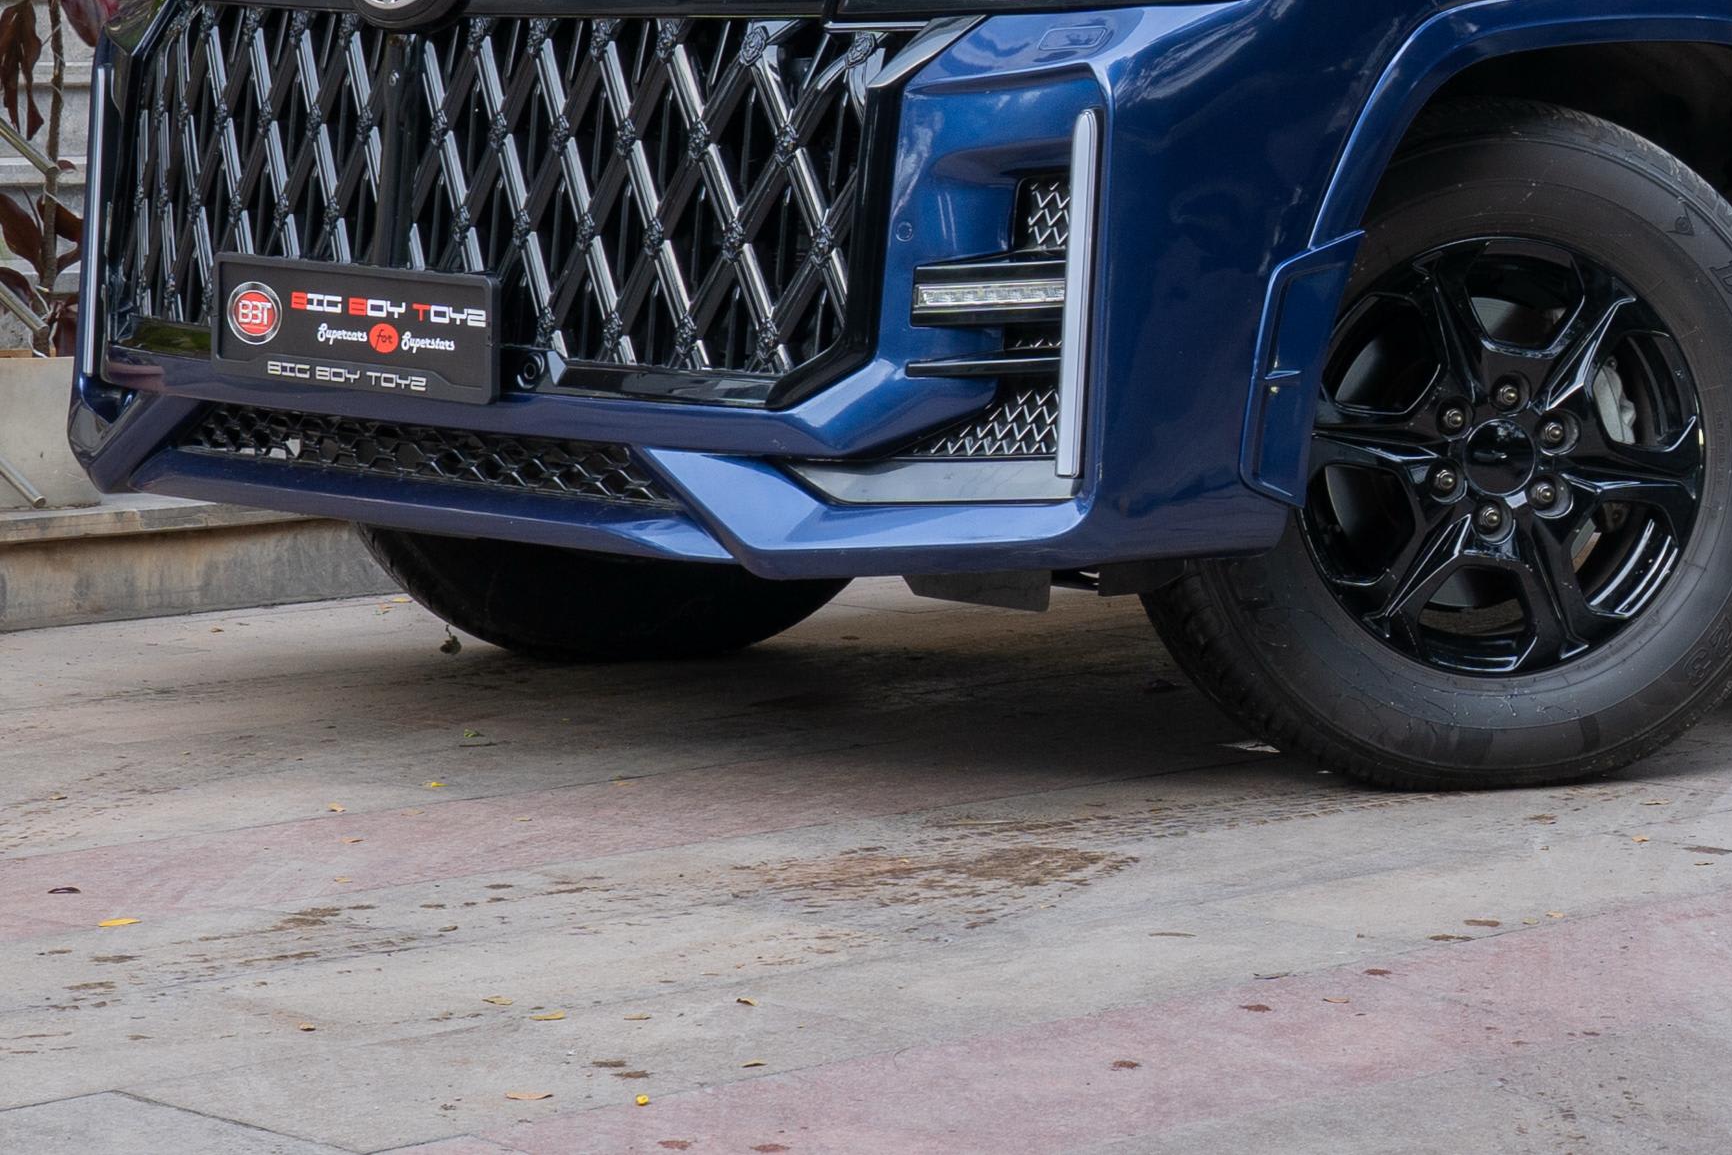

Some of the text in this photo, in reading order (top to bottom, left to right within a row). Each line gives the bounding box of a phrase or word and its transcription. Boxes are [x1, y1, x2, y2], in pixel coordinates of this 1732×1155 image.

[290, 291, 487, 328] BIG BOY TOYZ
[317, 323, 456, 353] Supercars for Superstars
[267, 360, 427, 391] BIG BOY TOYZ
